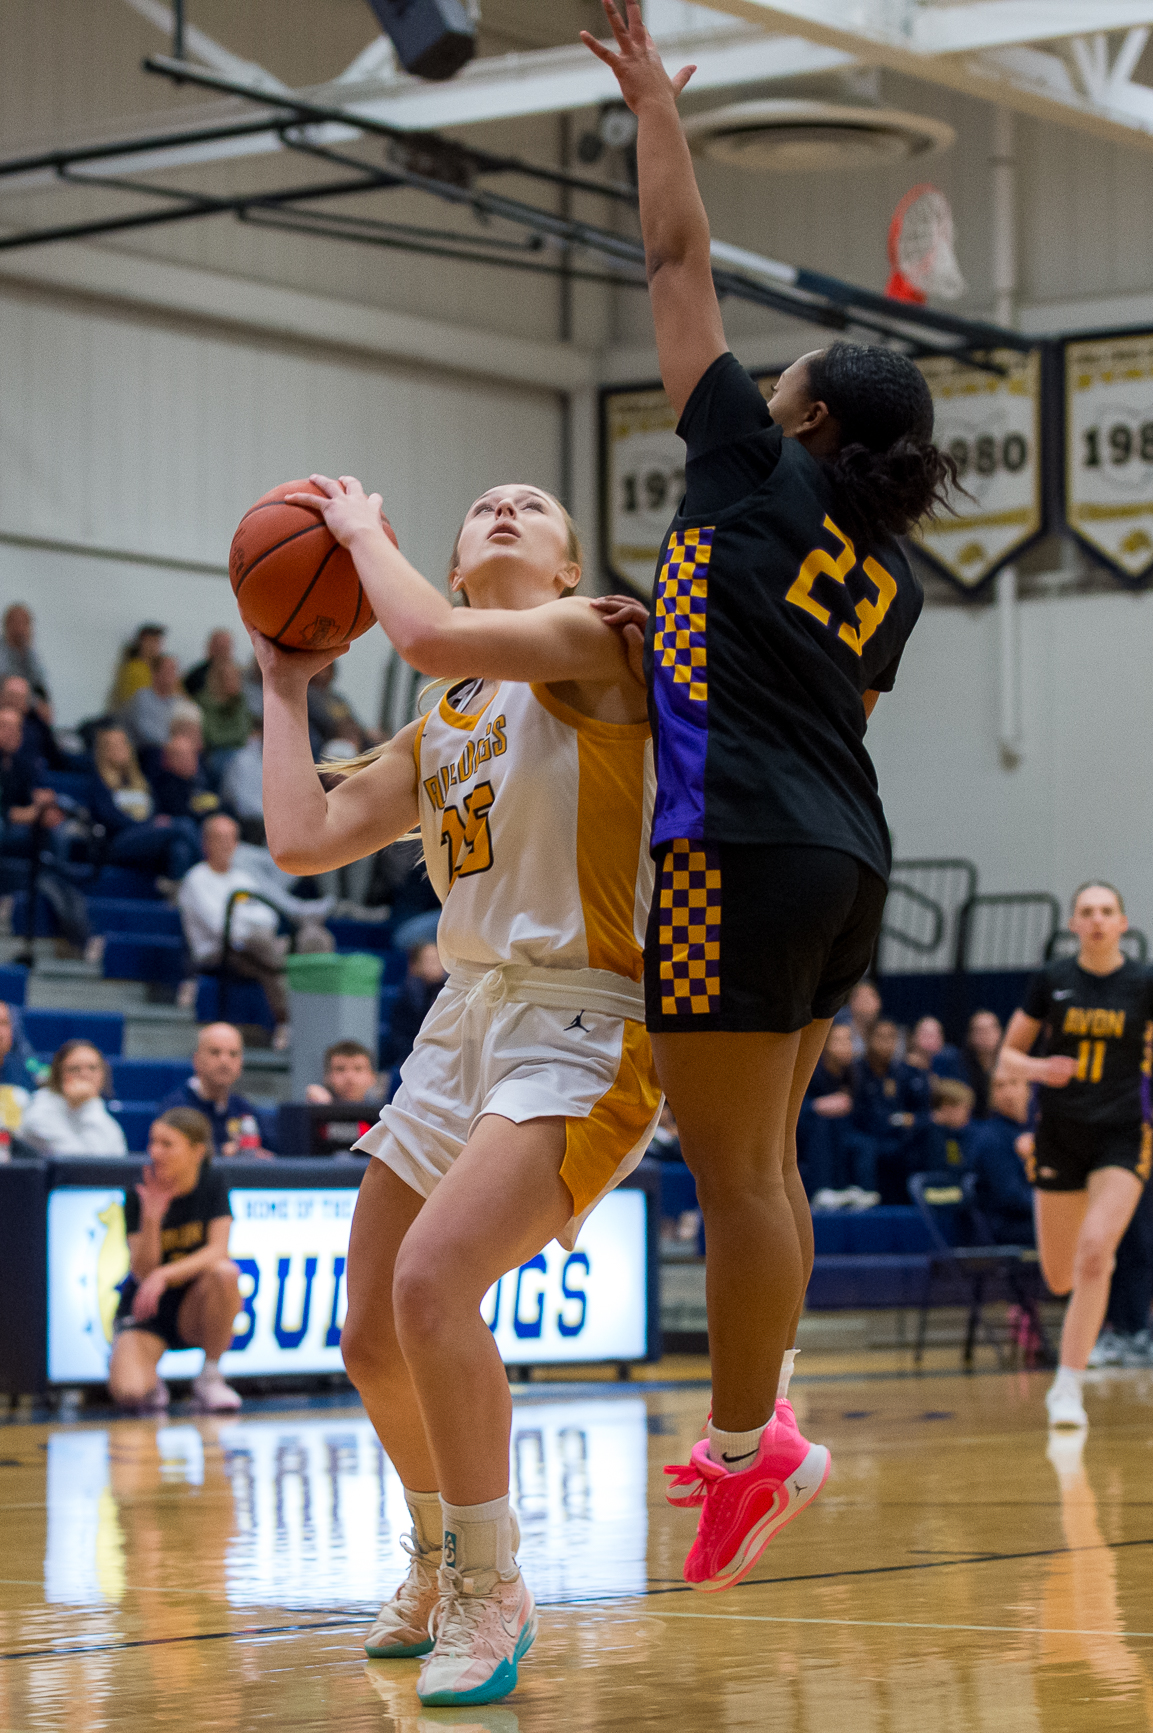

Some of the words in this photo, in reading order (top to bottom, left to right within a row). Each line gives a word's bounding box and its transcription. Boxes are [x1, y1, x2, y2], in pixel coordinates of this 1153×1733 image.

[784, 512, 898, 657] 23
[441, 779, 496, 900] 25
[1062, 1007, 1126, 1038] AVON
[1077, 1039, 1106, 1083] 11
